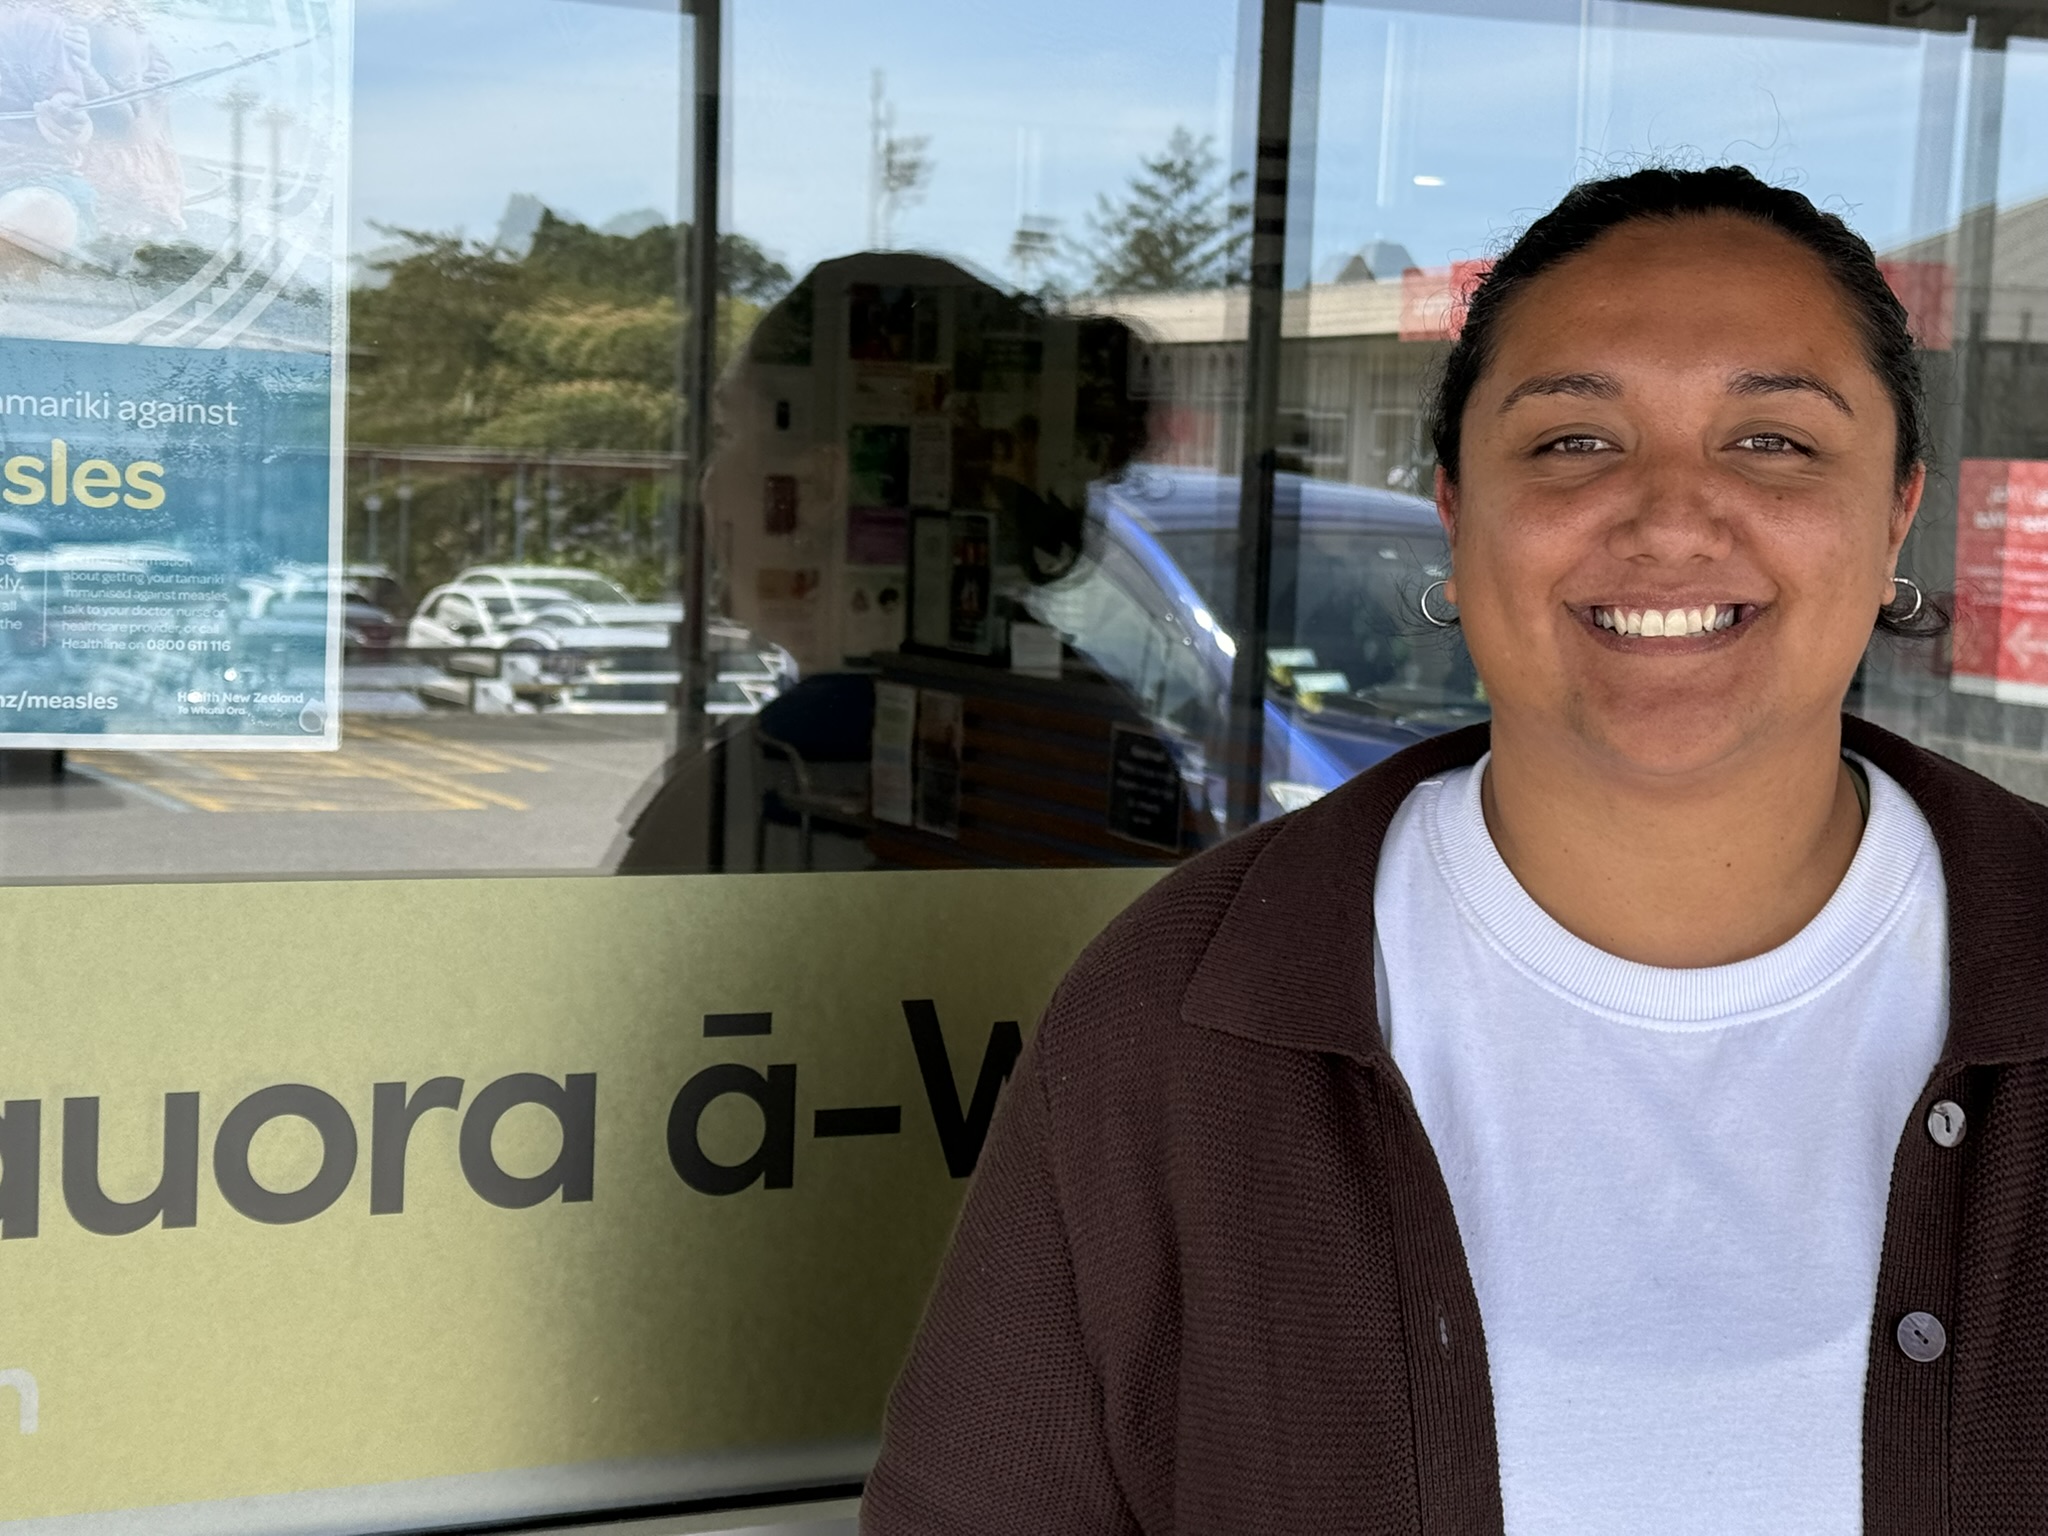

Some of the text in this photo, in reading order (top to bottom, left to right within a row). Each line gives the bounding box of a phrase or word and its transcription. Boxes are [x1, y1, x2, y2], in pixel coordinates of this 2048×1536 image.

[0, 390, 239, 429] mariki against
[2, 438, 166, 510] sles
[62, 570, 225, 586] about getting your tamariki
[133, 590, 176, 602] against
[62, 604, 86, 616] talk
[86, 605, 101, 616] to
[101, 606, 130, 617] your
[176, 607, 212, 618] nurse
[61, 638, 232, 653] Healthline on 0800 611 116
[222, 692, 251, 704] New
[252, 692, 305, 704] Zealand
[177, 706, 247, 716] Te Whatu Ora
[0, 1071, 598, 1242] uora
